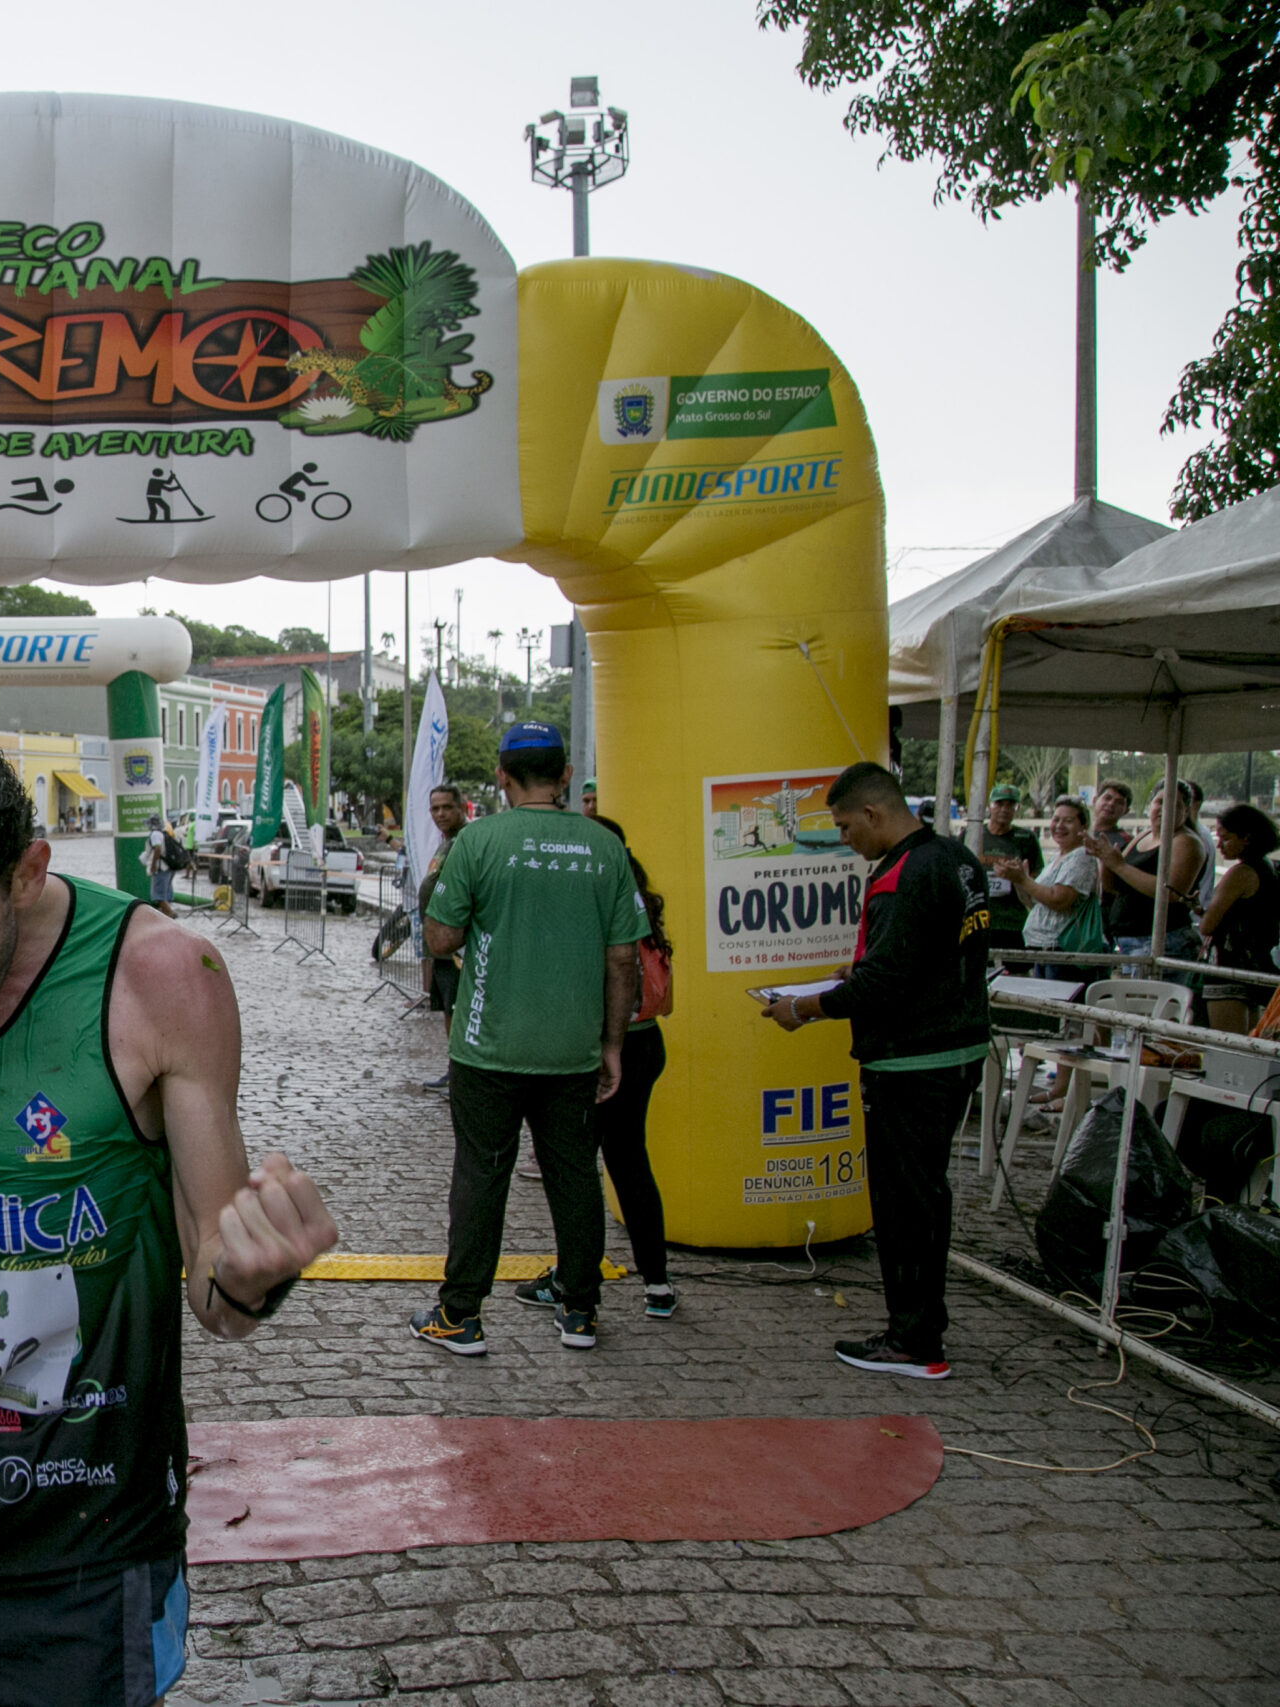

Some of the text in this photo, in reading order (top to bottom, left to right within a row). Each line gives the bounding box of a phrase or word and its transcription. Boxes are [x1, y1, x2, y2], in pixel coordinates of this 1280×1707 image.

[676, 385, 821, 405] GOVERNO DO ESTADO
[676, 409, 771, 423] Mato Grosso do Sul
[39, 427, 255, 460] AVENTURA
[608, 458, 843, 507] FUNDESPORTE
[754, 863, 855, 879] PREFEITURA DE
[719, 939, 803, 950] CONSTRUINDO
[807, 935, 840, 945] NOSSA
[729, 955, 742, 965] 16
[755, 953, 769, 963] 18
[771, 952, 785, 963] de
[788, 947, 839, 961] Novembro
[841, 946, 852, 956] de
[464, 931, 492, 1046] FEDERAÇÕES
[762, 1082, 851, 1134] FIE
[744, 1146, 866, 1190] DENÚNCIA 181
[766, 1157, 814, 1172] DISQUE
[744, 1196, 774, 1204] DIGA
[825, 1185, 863, 1197] DROGAS
[36, 1458, 86, 1473] MONICA
[36, 1463, 115, 1488] BADZIAK
[87, 1477, 116, 1487] STORE
